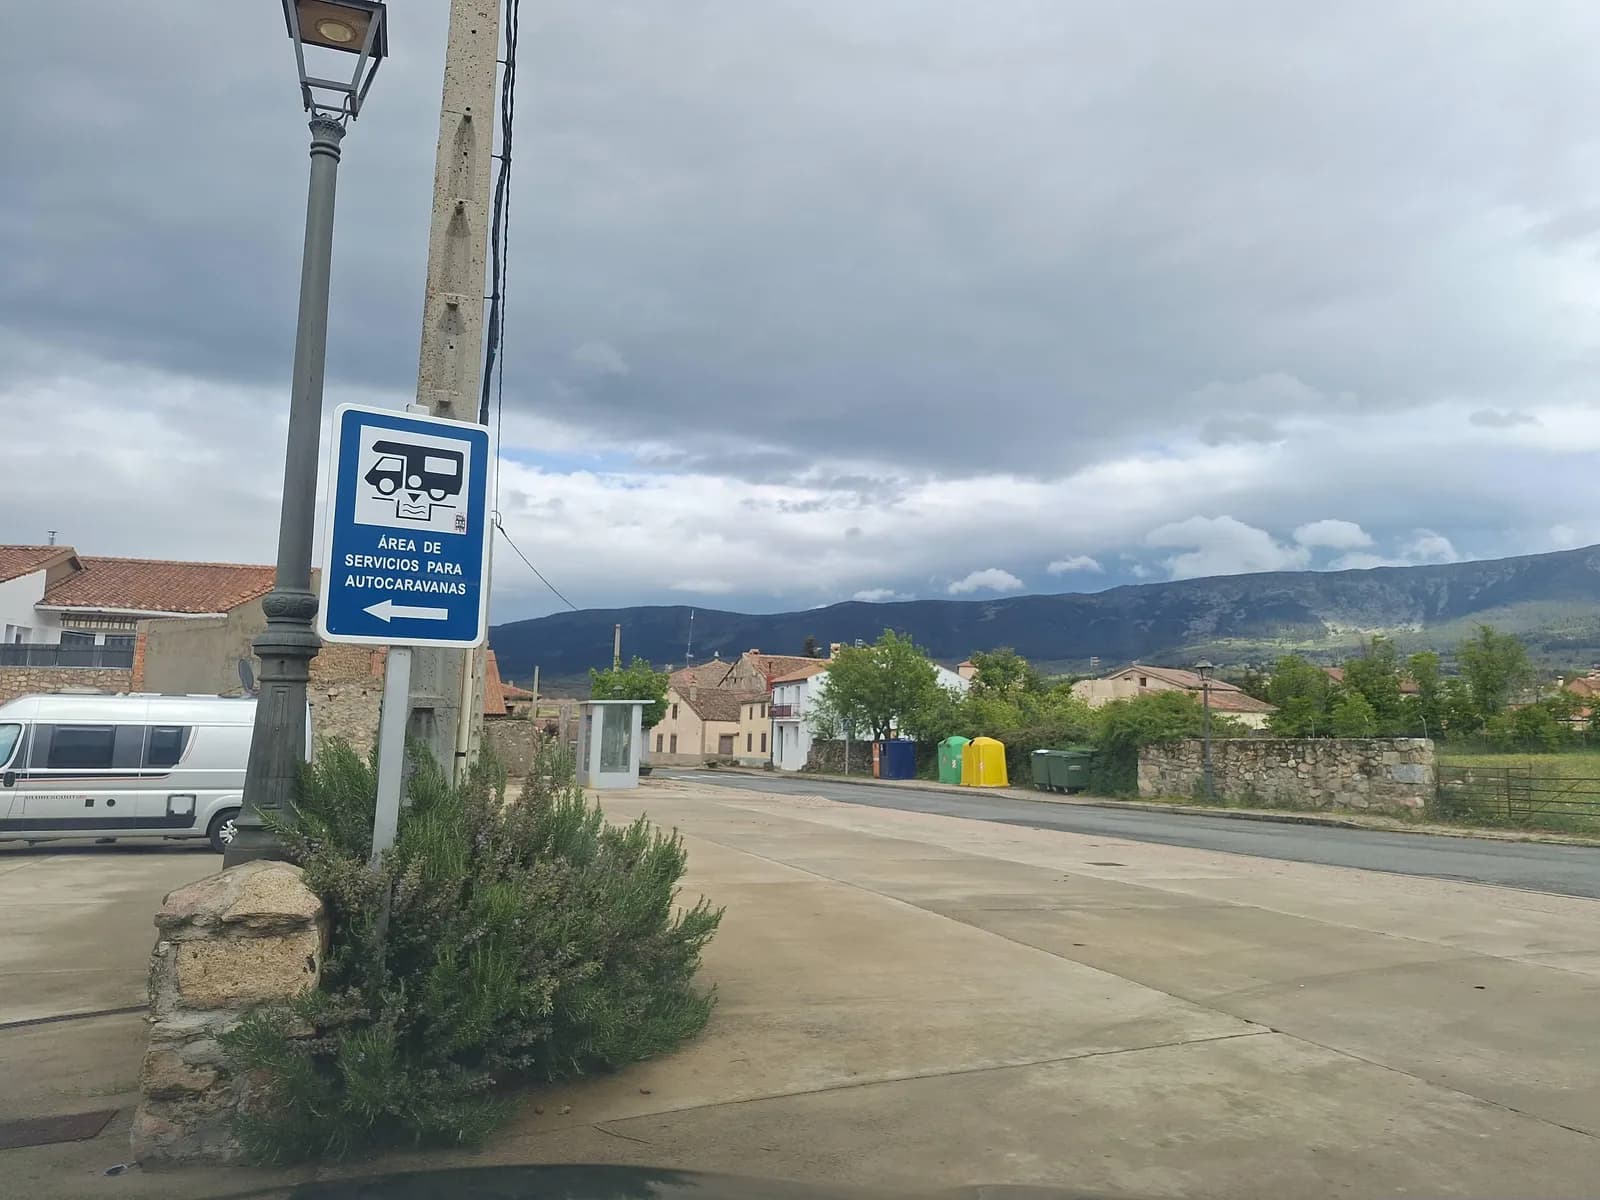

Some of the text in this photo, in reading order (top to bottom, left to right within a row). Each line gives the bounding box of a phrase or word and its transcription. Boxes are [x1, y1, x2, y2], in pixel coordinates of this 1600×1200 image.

[378, 534, 441, 554] ÁREA DE
[345, 554, 462, 575] SERVICIOS PARA
[345, 575, 466, 595] AUTOCARAVANAS
